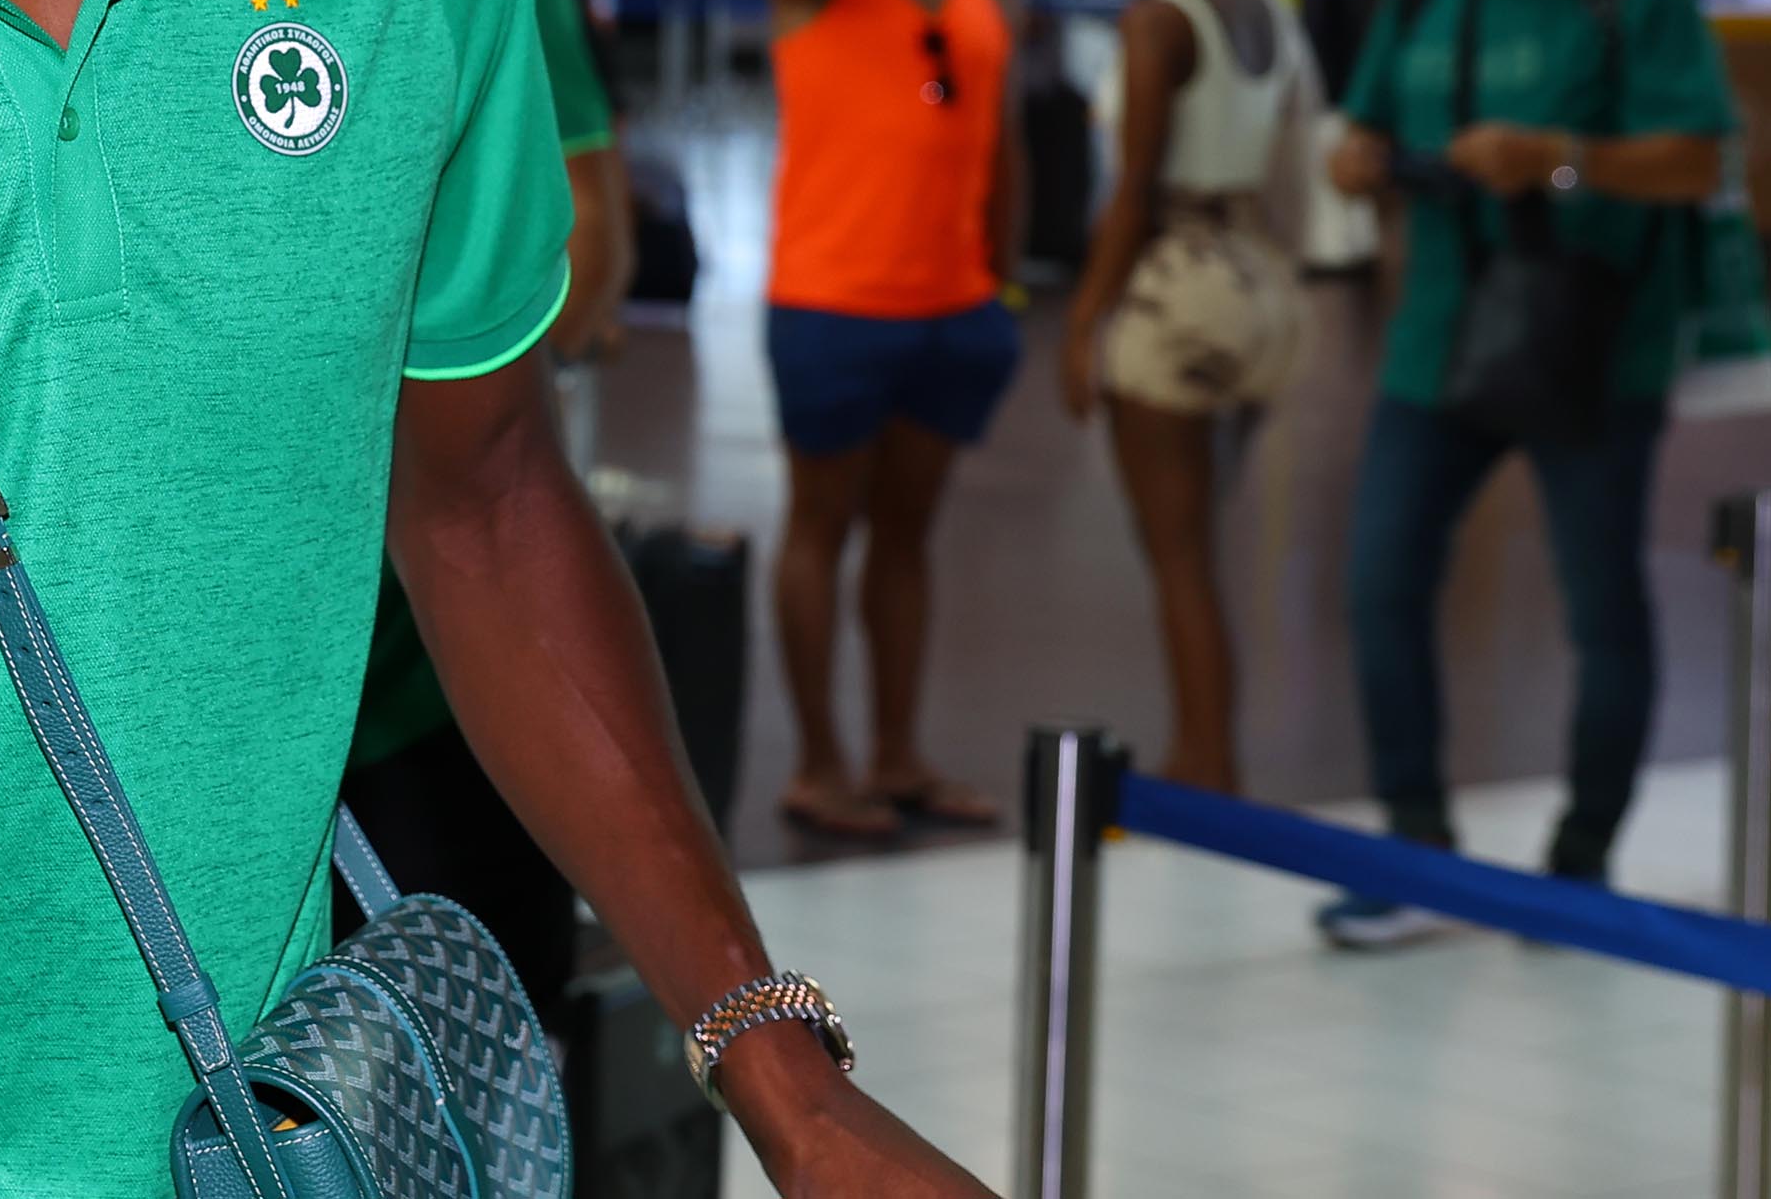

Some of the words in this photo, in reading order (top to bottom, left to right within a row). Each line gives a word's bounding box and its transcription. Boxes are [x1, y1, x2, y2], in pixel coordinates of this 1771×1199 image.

[240, 29, 286, 74] ΑΘΛΗΤΙΚΟΣ
[287, 29, 334, 66] ΣΥΛΛΟΓΟΣ
[275, 81, 306, 95] 1948
[249, 116, 295, 148] ΟΜΟΝΟΙΑ
